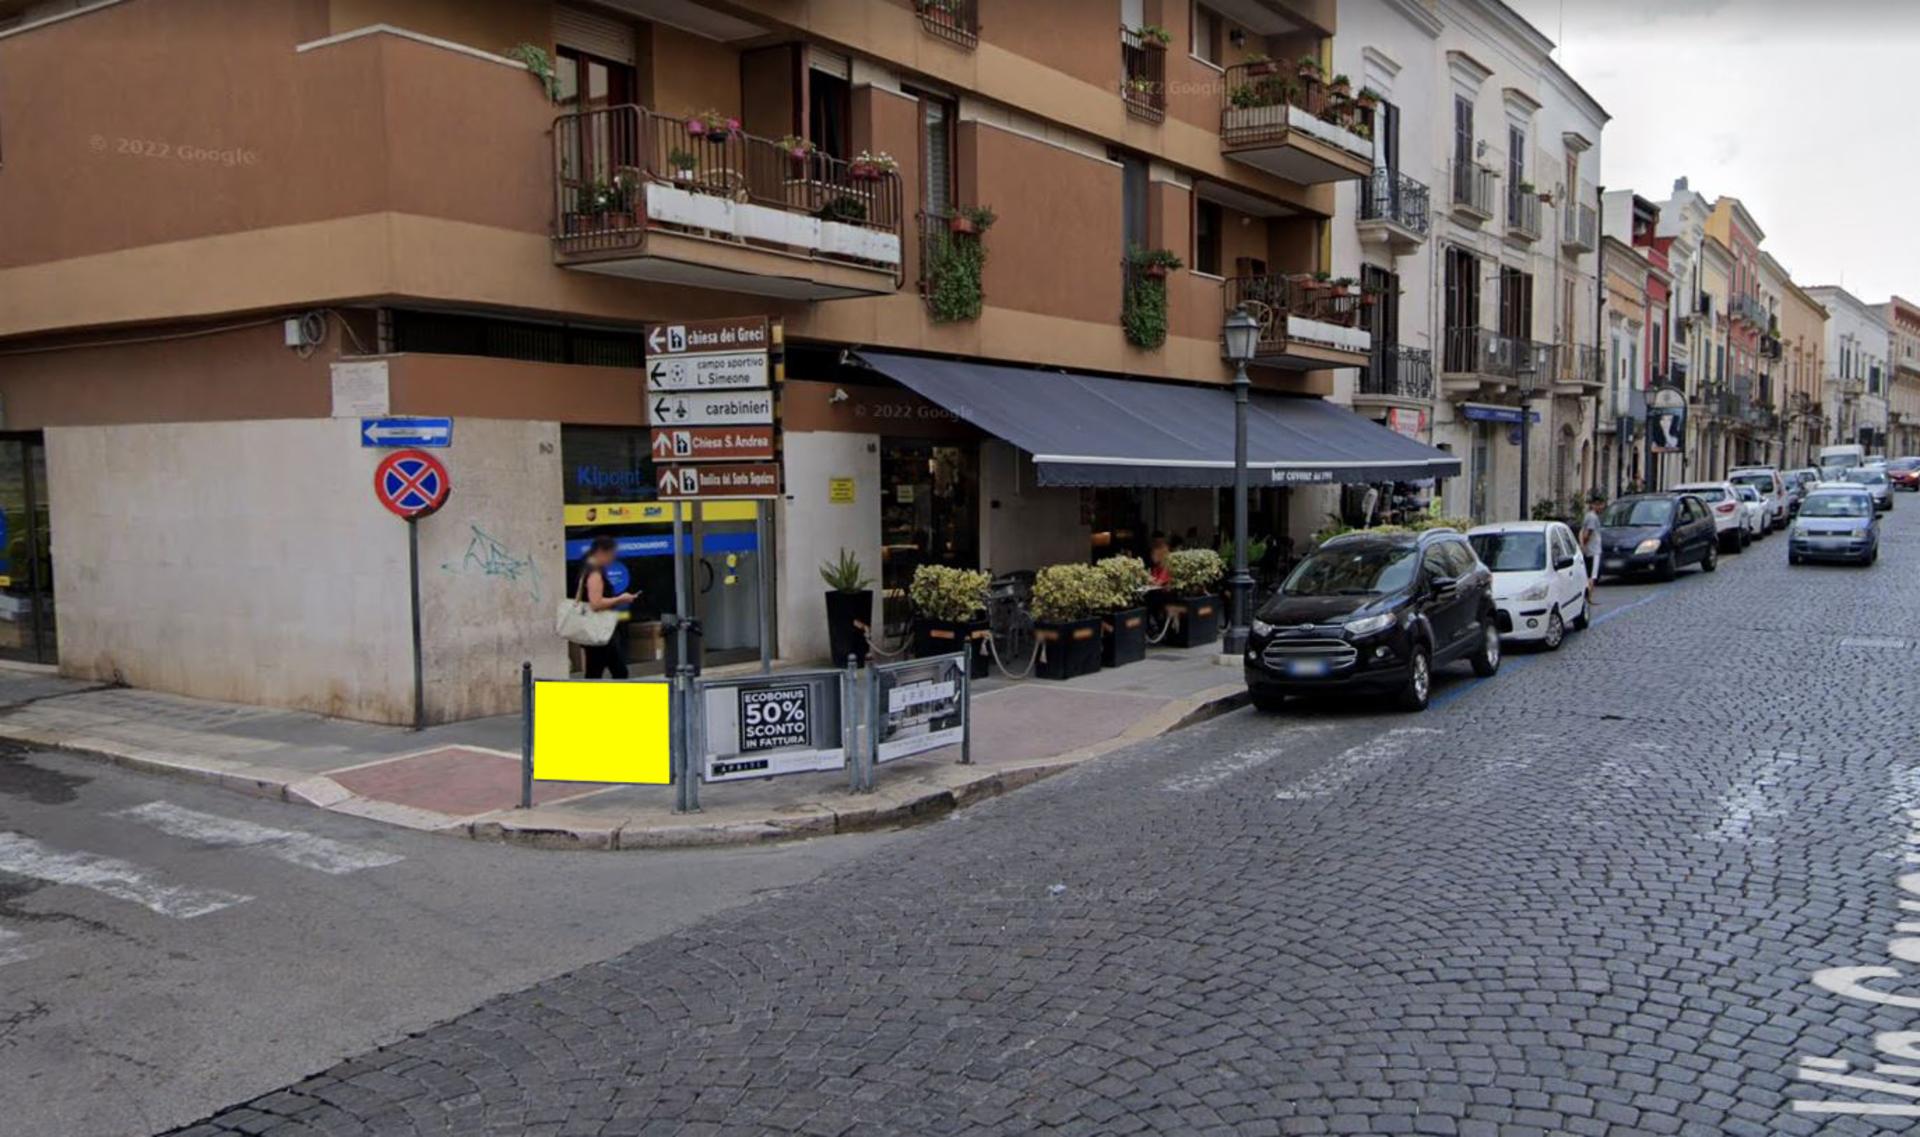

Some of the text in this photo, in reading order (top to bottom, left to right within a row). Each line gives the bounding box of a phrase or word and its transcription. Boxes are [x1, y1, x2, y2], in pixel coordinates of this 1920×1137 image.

[688, 326, 764, 345] chiesa dei Greci
[697, 358, 764, 371] campo sportivo
[708, 372, 751, 384] Simeone
[705, 400, 769, 415] carabinieri
[692, 435, 769, 449] Chiesa S. Andrea
[744, 689, 804, 703] ECOBONUS
[745, 700, 805, 724] 50%
[746, 722, 805, 737] SCONTO
[746, 735, 806, 748] IN FATTURA
